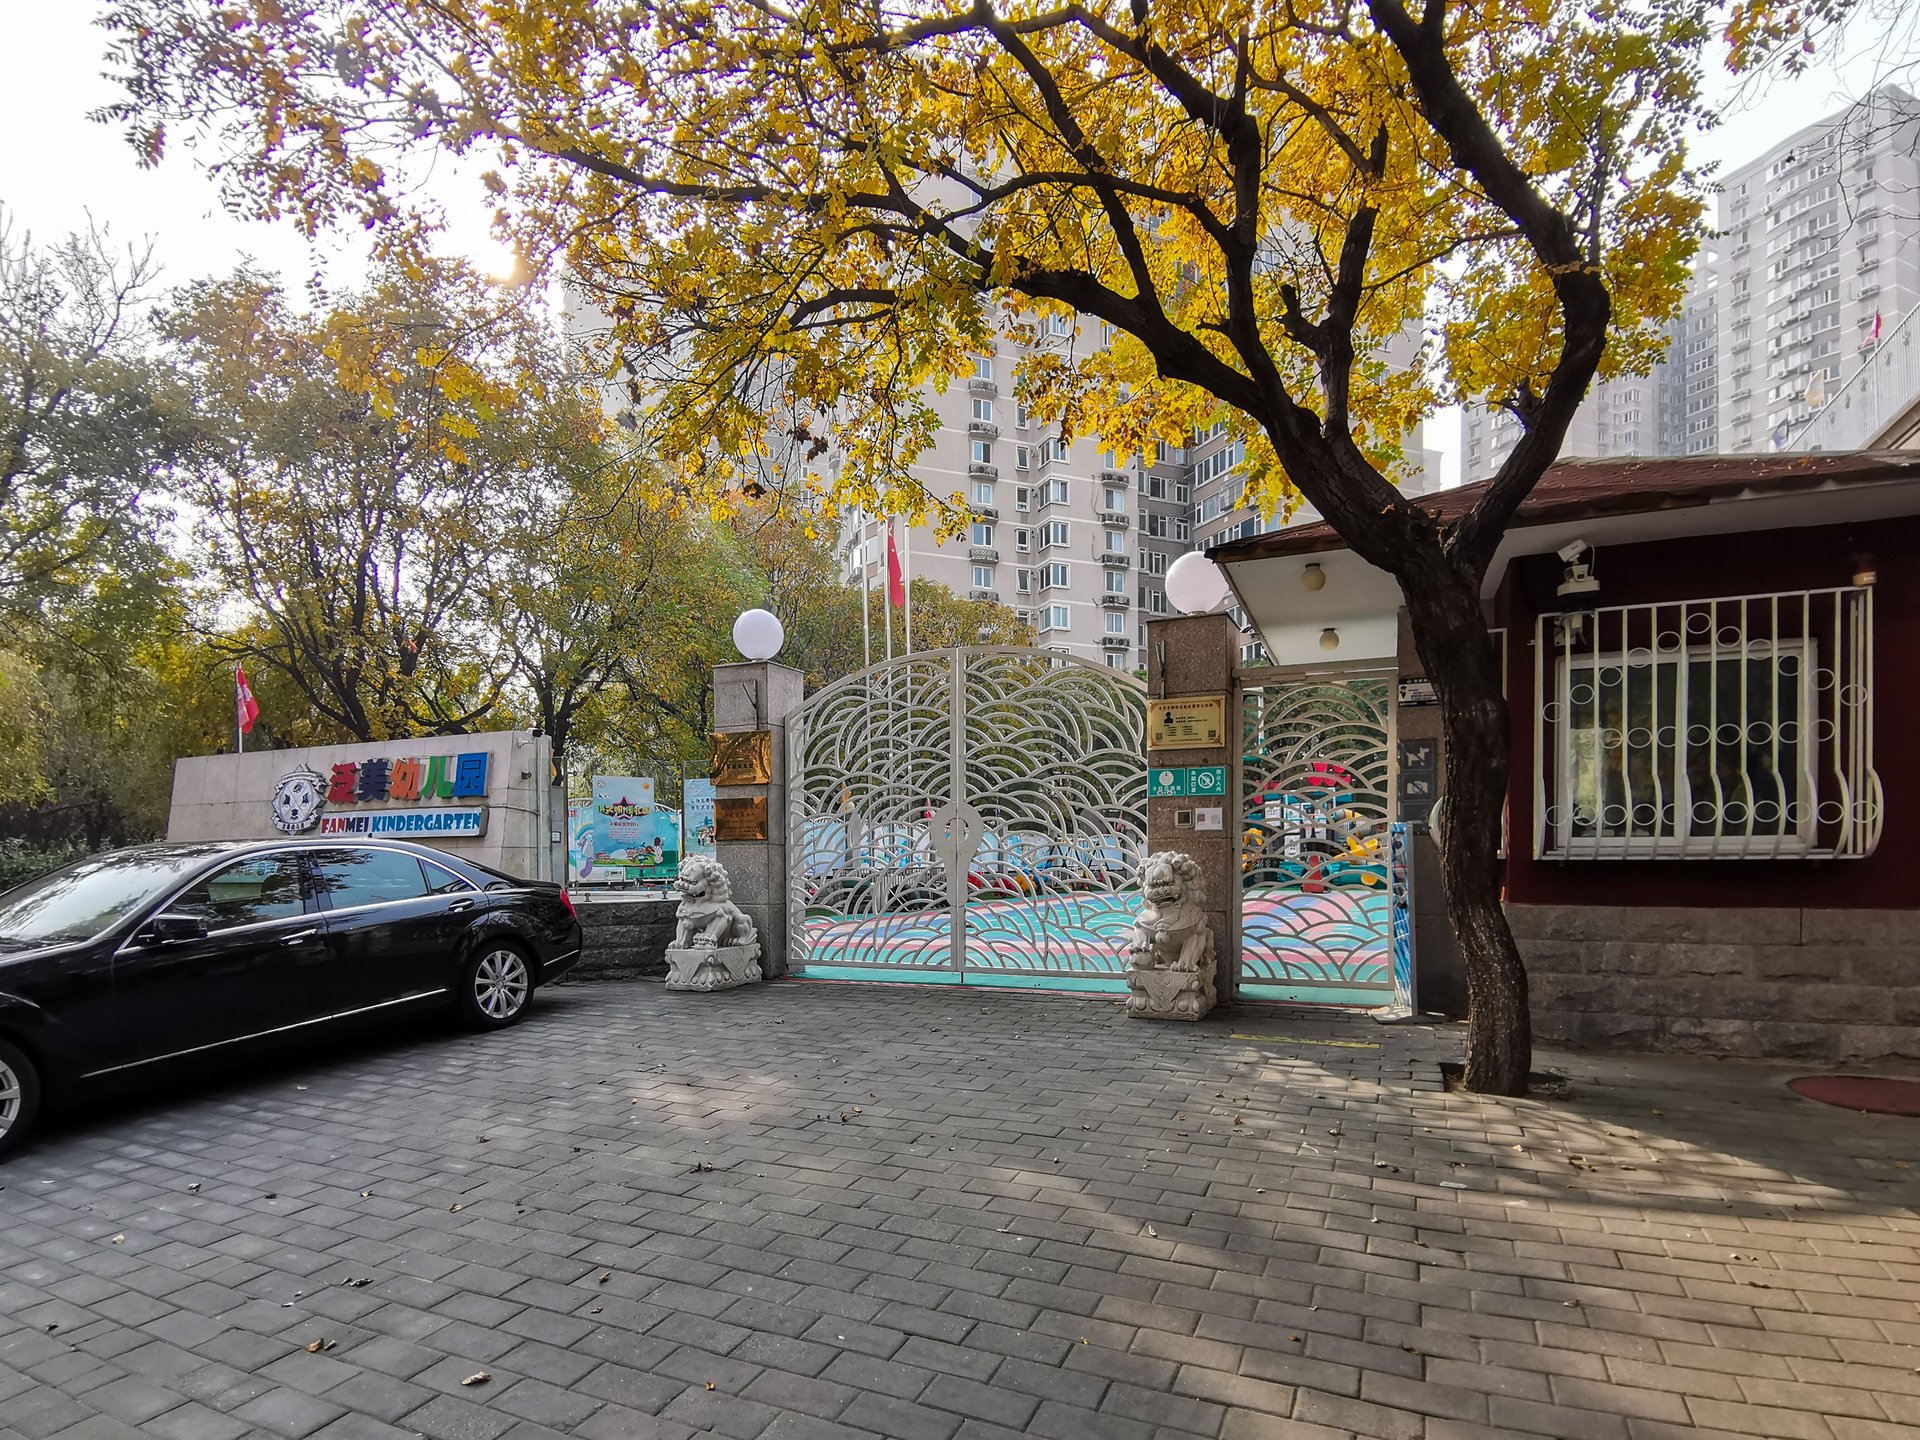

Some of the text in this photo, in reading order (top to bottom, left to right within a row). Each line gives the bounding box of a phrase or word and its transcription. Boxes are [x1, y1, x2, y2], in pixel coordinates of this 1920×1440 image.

[327, 752, 487, 802] 泛美幼儿园
[321, 816, 369, 834] FANMEI
[371, 812, 481, 833] KINDERGARTEN
